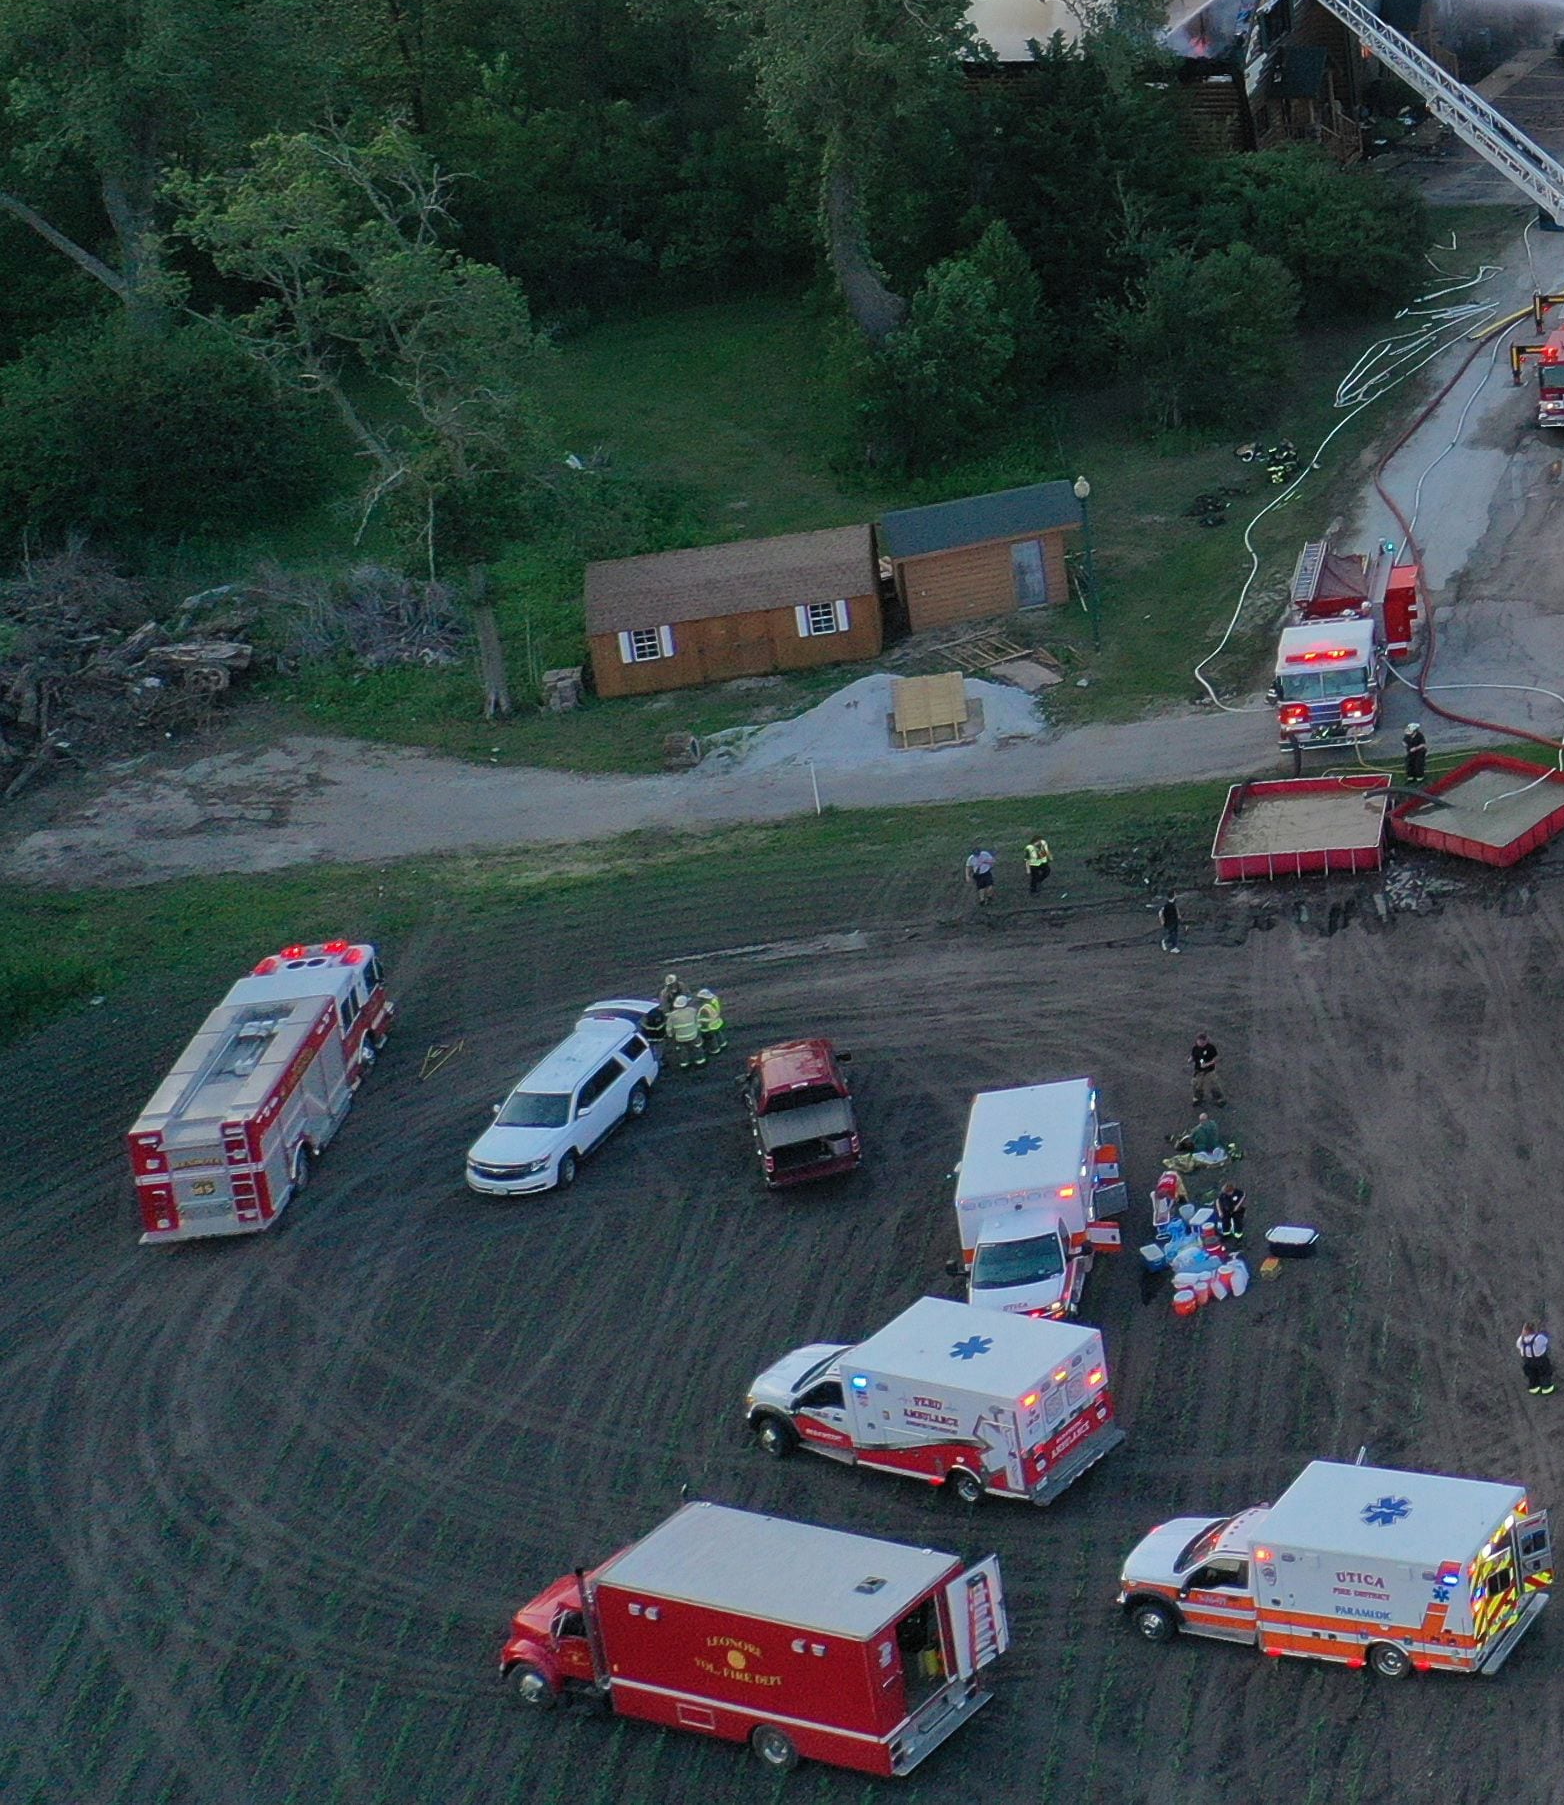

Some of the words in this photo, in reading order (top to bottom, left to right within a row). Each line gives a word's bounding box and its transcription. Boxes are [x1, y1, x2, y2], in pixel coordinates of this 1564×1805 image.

[1335, 1571, 1385, 1589] UTICA
[1332, 1587, 1352, 1596] FIRE
[1353, 1589, 1391, 1601] DISTRICT
[1335, 1605, 1392, 1621] PARAMEDIC
[706, 1635, 763, 1659] LEONORE
[723, 1668, 752, 1684] FIRE
